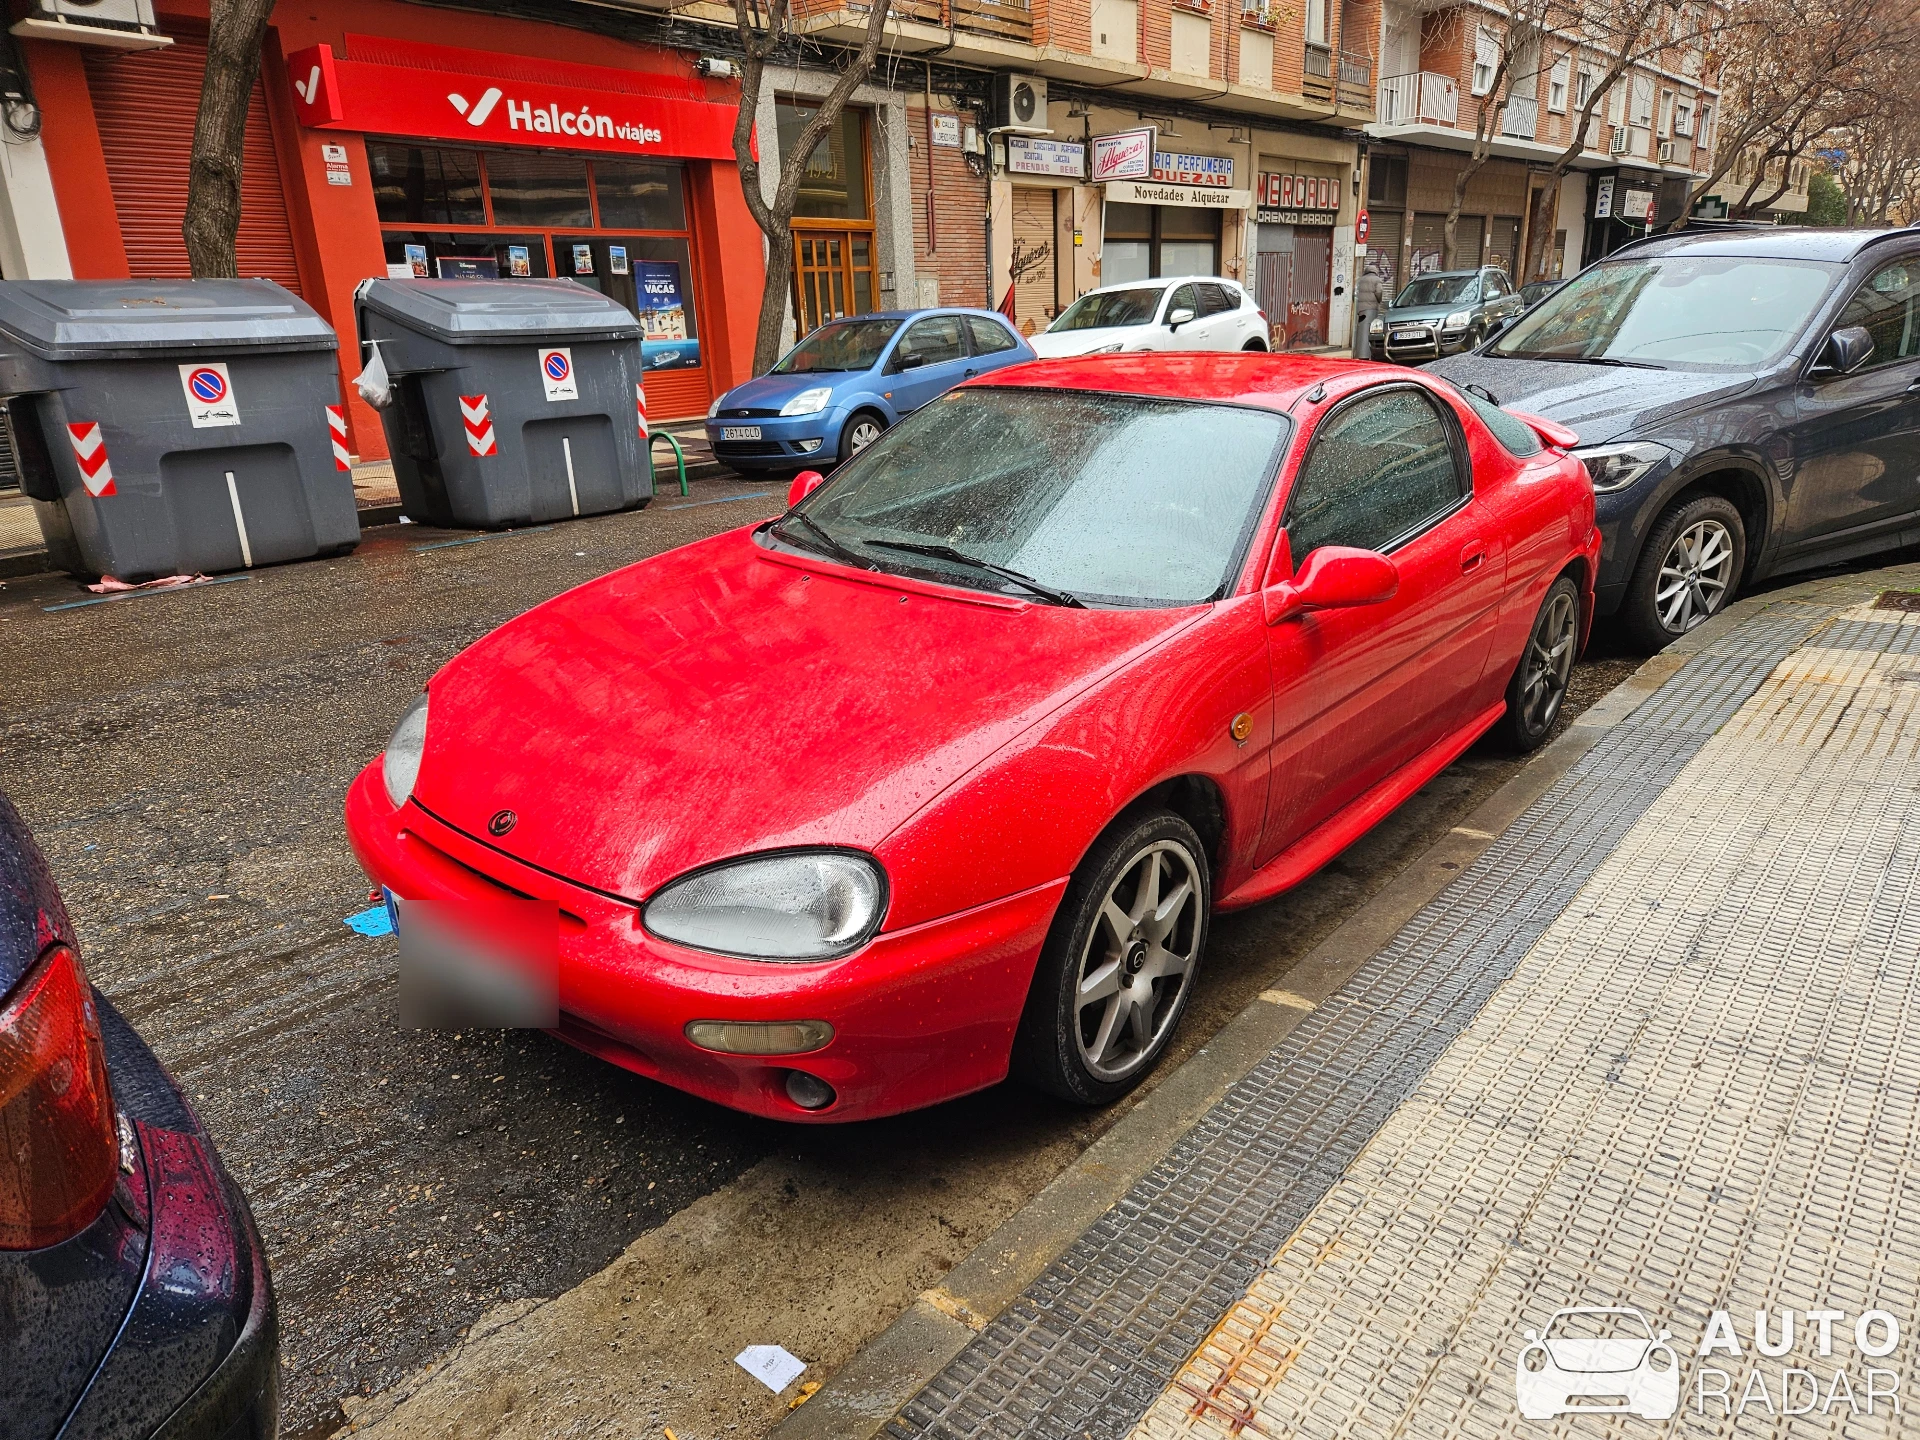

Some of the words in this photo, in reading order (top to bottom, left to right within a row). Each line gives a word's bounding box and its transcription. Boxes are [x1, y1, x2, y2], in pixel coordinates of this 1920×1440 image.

[507, 99, 614, 139] Halcón
[615, 122, 662, 145] viajes
[942, 121, 955, 129] CALLE
[1010, 139, 1029, 149] MERCERIA
[1015, 161, 1050, 172] PRENDAS
[1060, 165, 1079, 175] BEBE
[1177, 155, 1232, 175] PERFUMERIA
[1134, 185, 1184, 202] Novedades
[1191, 190, 1230, 206] Alquézar
[1257, 173, 1340, 208] MERCADO
[1301, 213, 1333, 225] PARDO
[644, 284, 675, 294] VACAS
